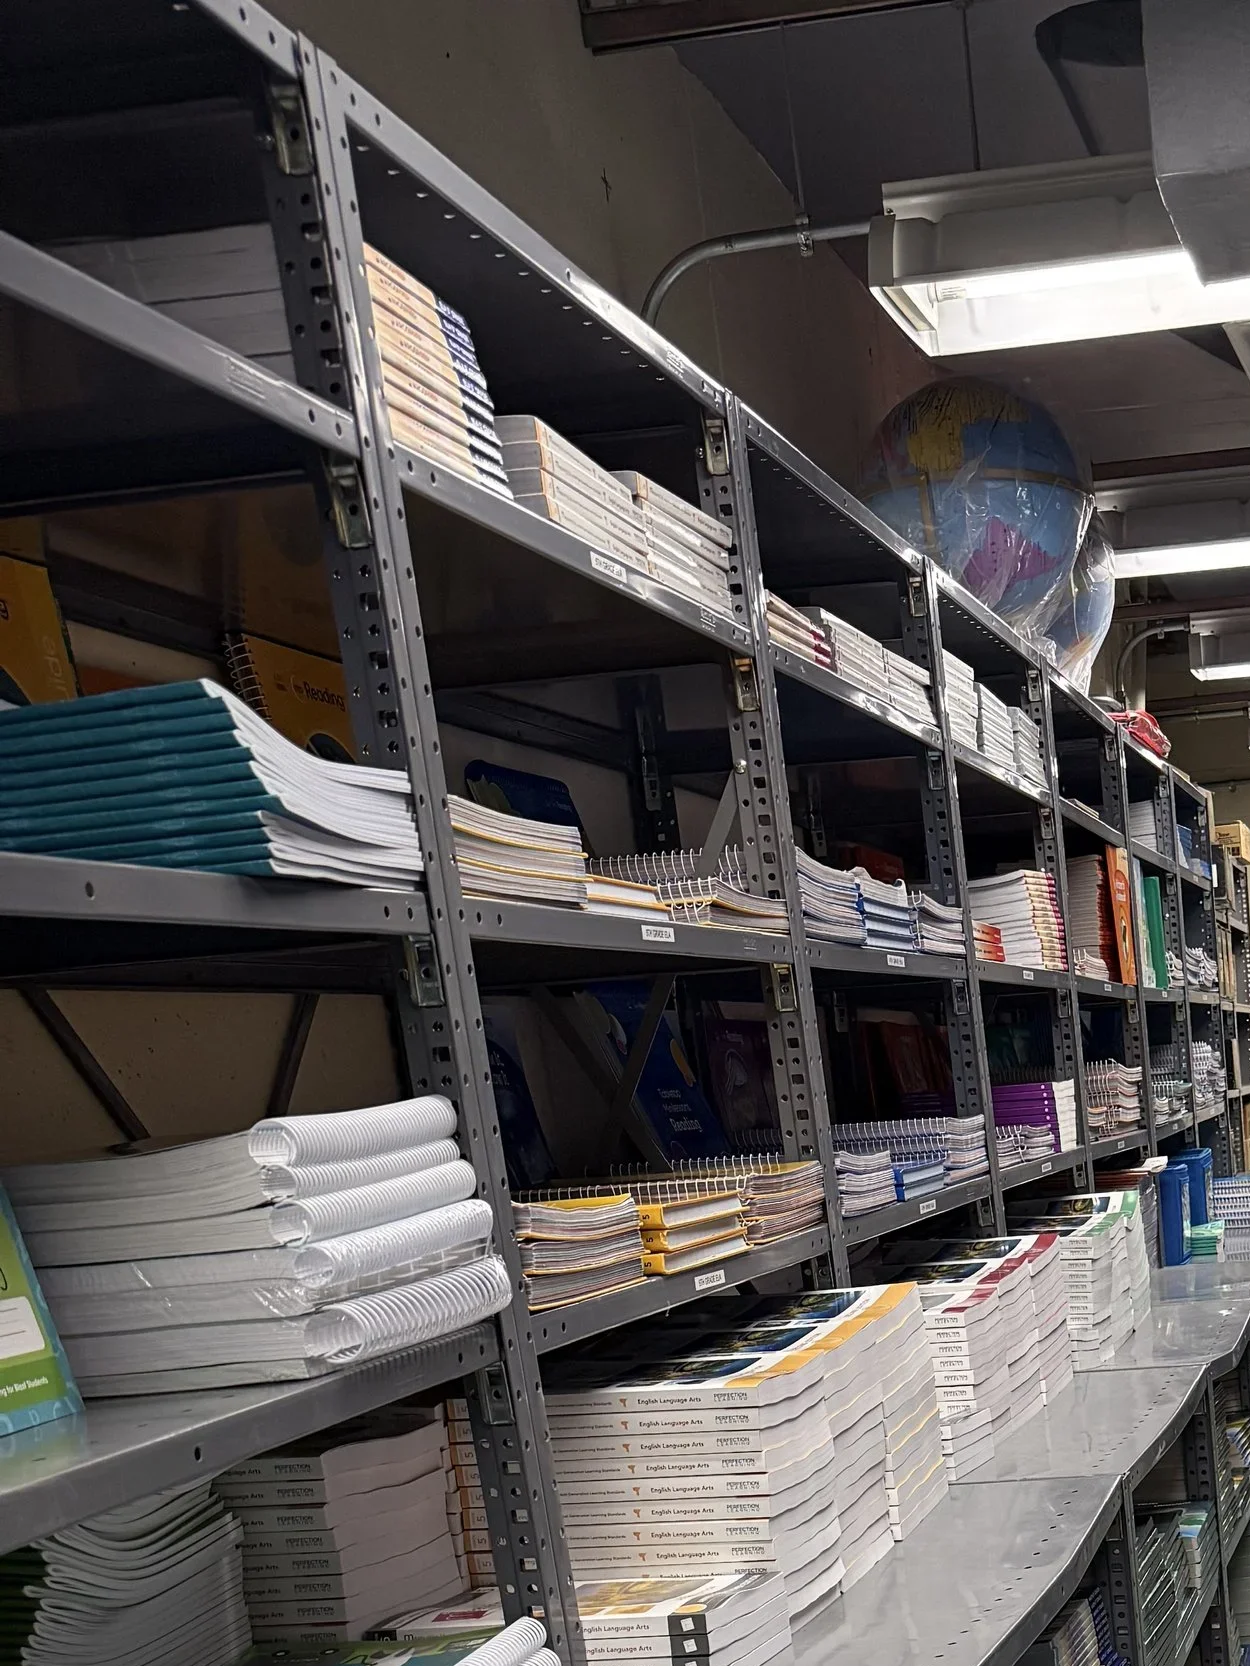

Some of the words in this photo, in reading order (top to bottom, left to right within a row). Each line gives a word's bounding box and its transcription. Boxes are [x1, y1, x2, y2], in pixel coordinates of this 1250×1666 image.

[303, 681, 346, 711] Reading
[672, 1116, 703, 1132] Reading
[26, 1376, 49, 1390] Students
[637, 1397, 656, 1405] English
[659, 1396, 687, 1405] Language
[688, 1395, 702, 1404] Arts
[713, 1392, 747, 1400] PERFECTION
[639, 1420, 658, 1428] English
[660, 1418, 689, 1428] Language
[690, 1418, 703, 1426] Arts
[640, 1442, 660, 1450] English
[661, 1440, 690, 1451] Language
[691, 1440, 705, 1448] Arts
[716, 1436, 750, 1445] PERFECTION
[721, 1457, 755, 1465] PERFECTION
[646, 1463, 664, 1471] English
[665, 1462, 694, 1472] Language
[696, 1461, 710, 1469] Arts
[726, 1480, 760, 1488] PERFECTION
[650, 1486, 669, 1494] English
[671, 1485, 700, 1495] Language
[701, 1484, 714, 1492] Arts
[651, 1508, 670, 1516] English
[671, 1507, 700, 1516] Language
[701, 1506, 715, 1514] Arts
[726, 1503, 760, 1511] PERFECTION
[650, 1531, 670, 1539] English
[671, 1530, 700, 1540] Language
[701, 1529, 714, 1537] Arts
[725, 1526, 759, 1534] PERFECTION
[731, 1546, 765, 1554] PERFECTION
[656, 1552, 676, 1560] English
[677, 1551, 706, 1561] Language
[707, 1550, 720, 1558] Arts
[603, 1624, 634, 1634] Language
[636, 1623, 650, 1631] Arts
[586, 1646, 605, 1655] nglish
[606, 1645, 637, 1656] Language
[638, 1644, 653, 1652] Arts
